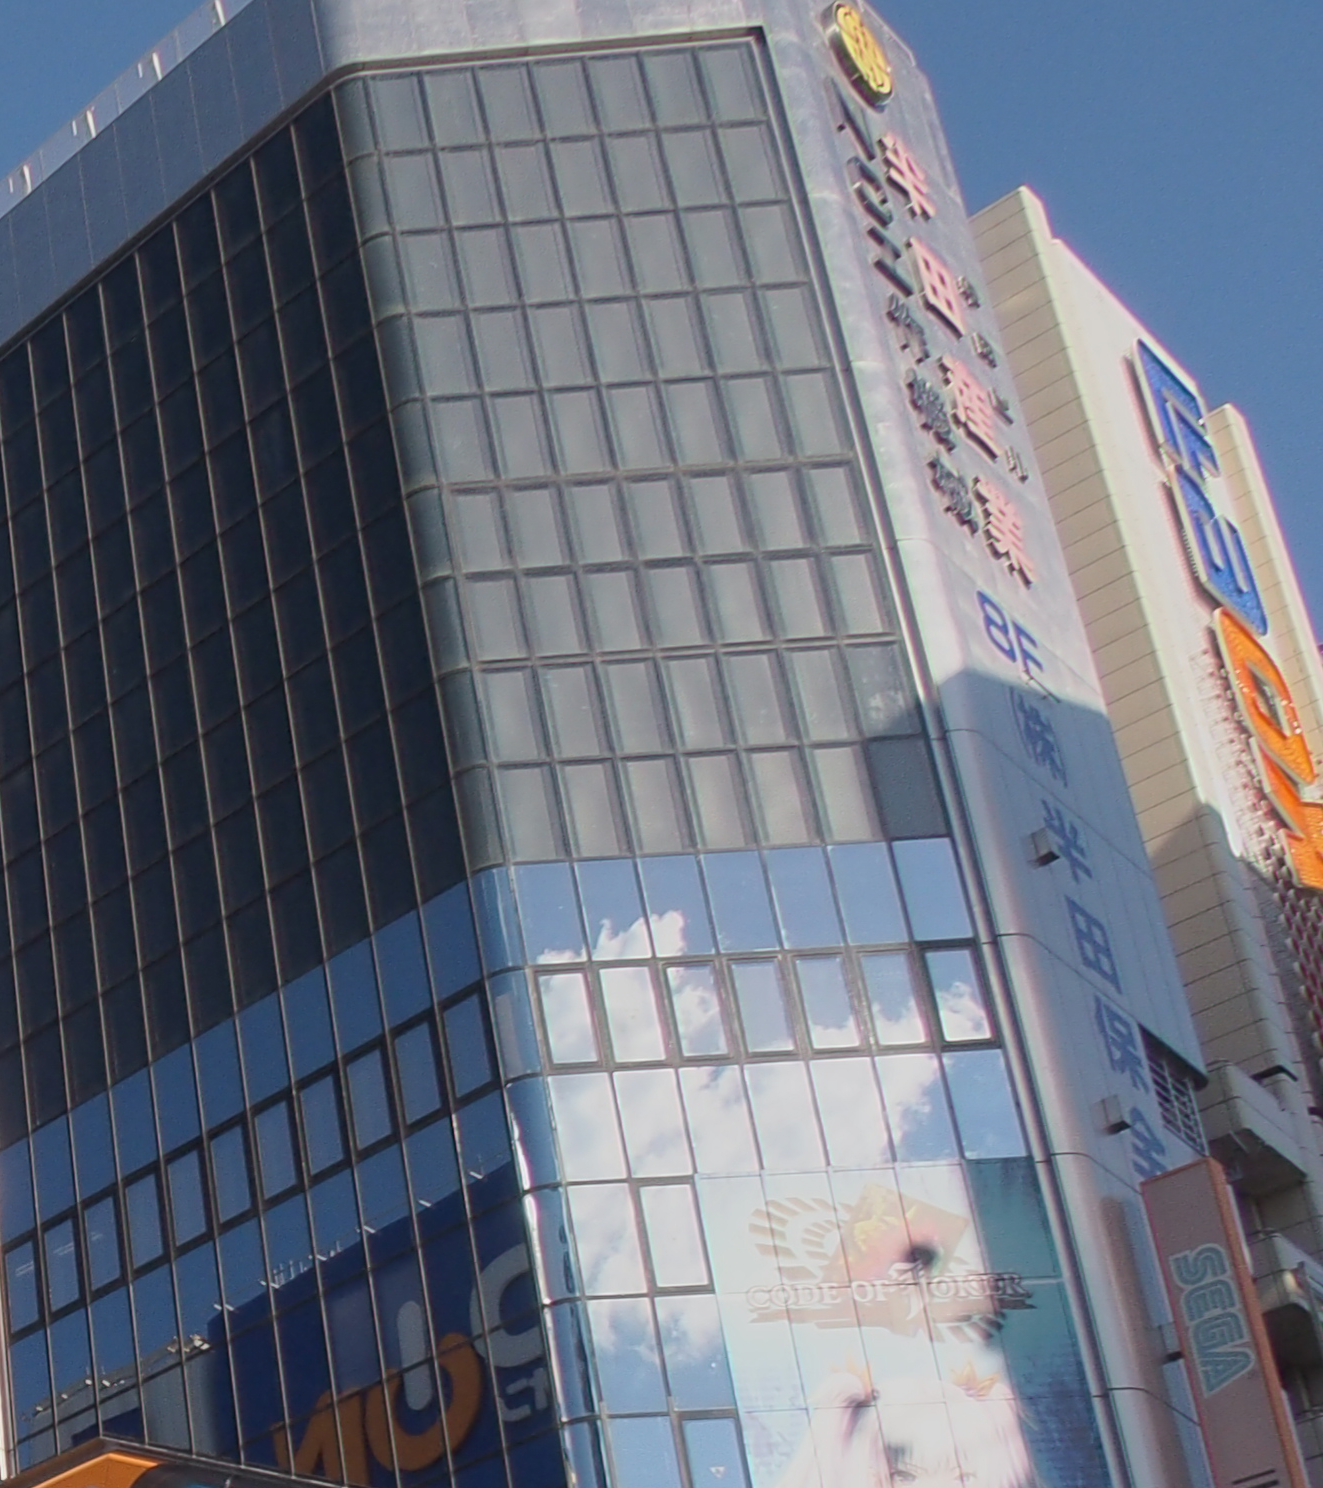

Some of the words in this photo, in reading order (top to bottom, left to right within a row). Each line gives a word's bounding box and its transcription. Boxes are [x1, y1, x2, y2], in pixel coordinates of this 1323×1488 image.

[977, 590, 1043, 672] 8F
[746, 1283, 838, 1311] CODE
[851, 1281, 891, 1304] OF
[890, 1262, 1029, 1320] JOKER
[1169, 1243, 1254, 1397] SEGA
